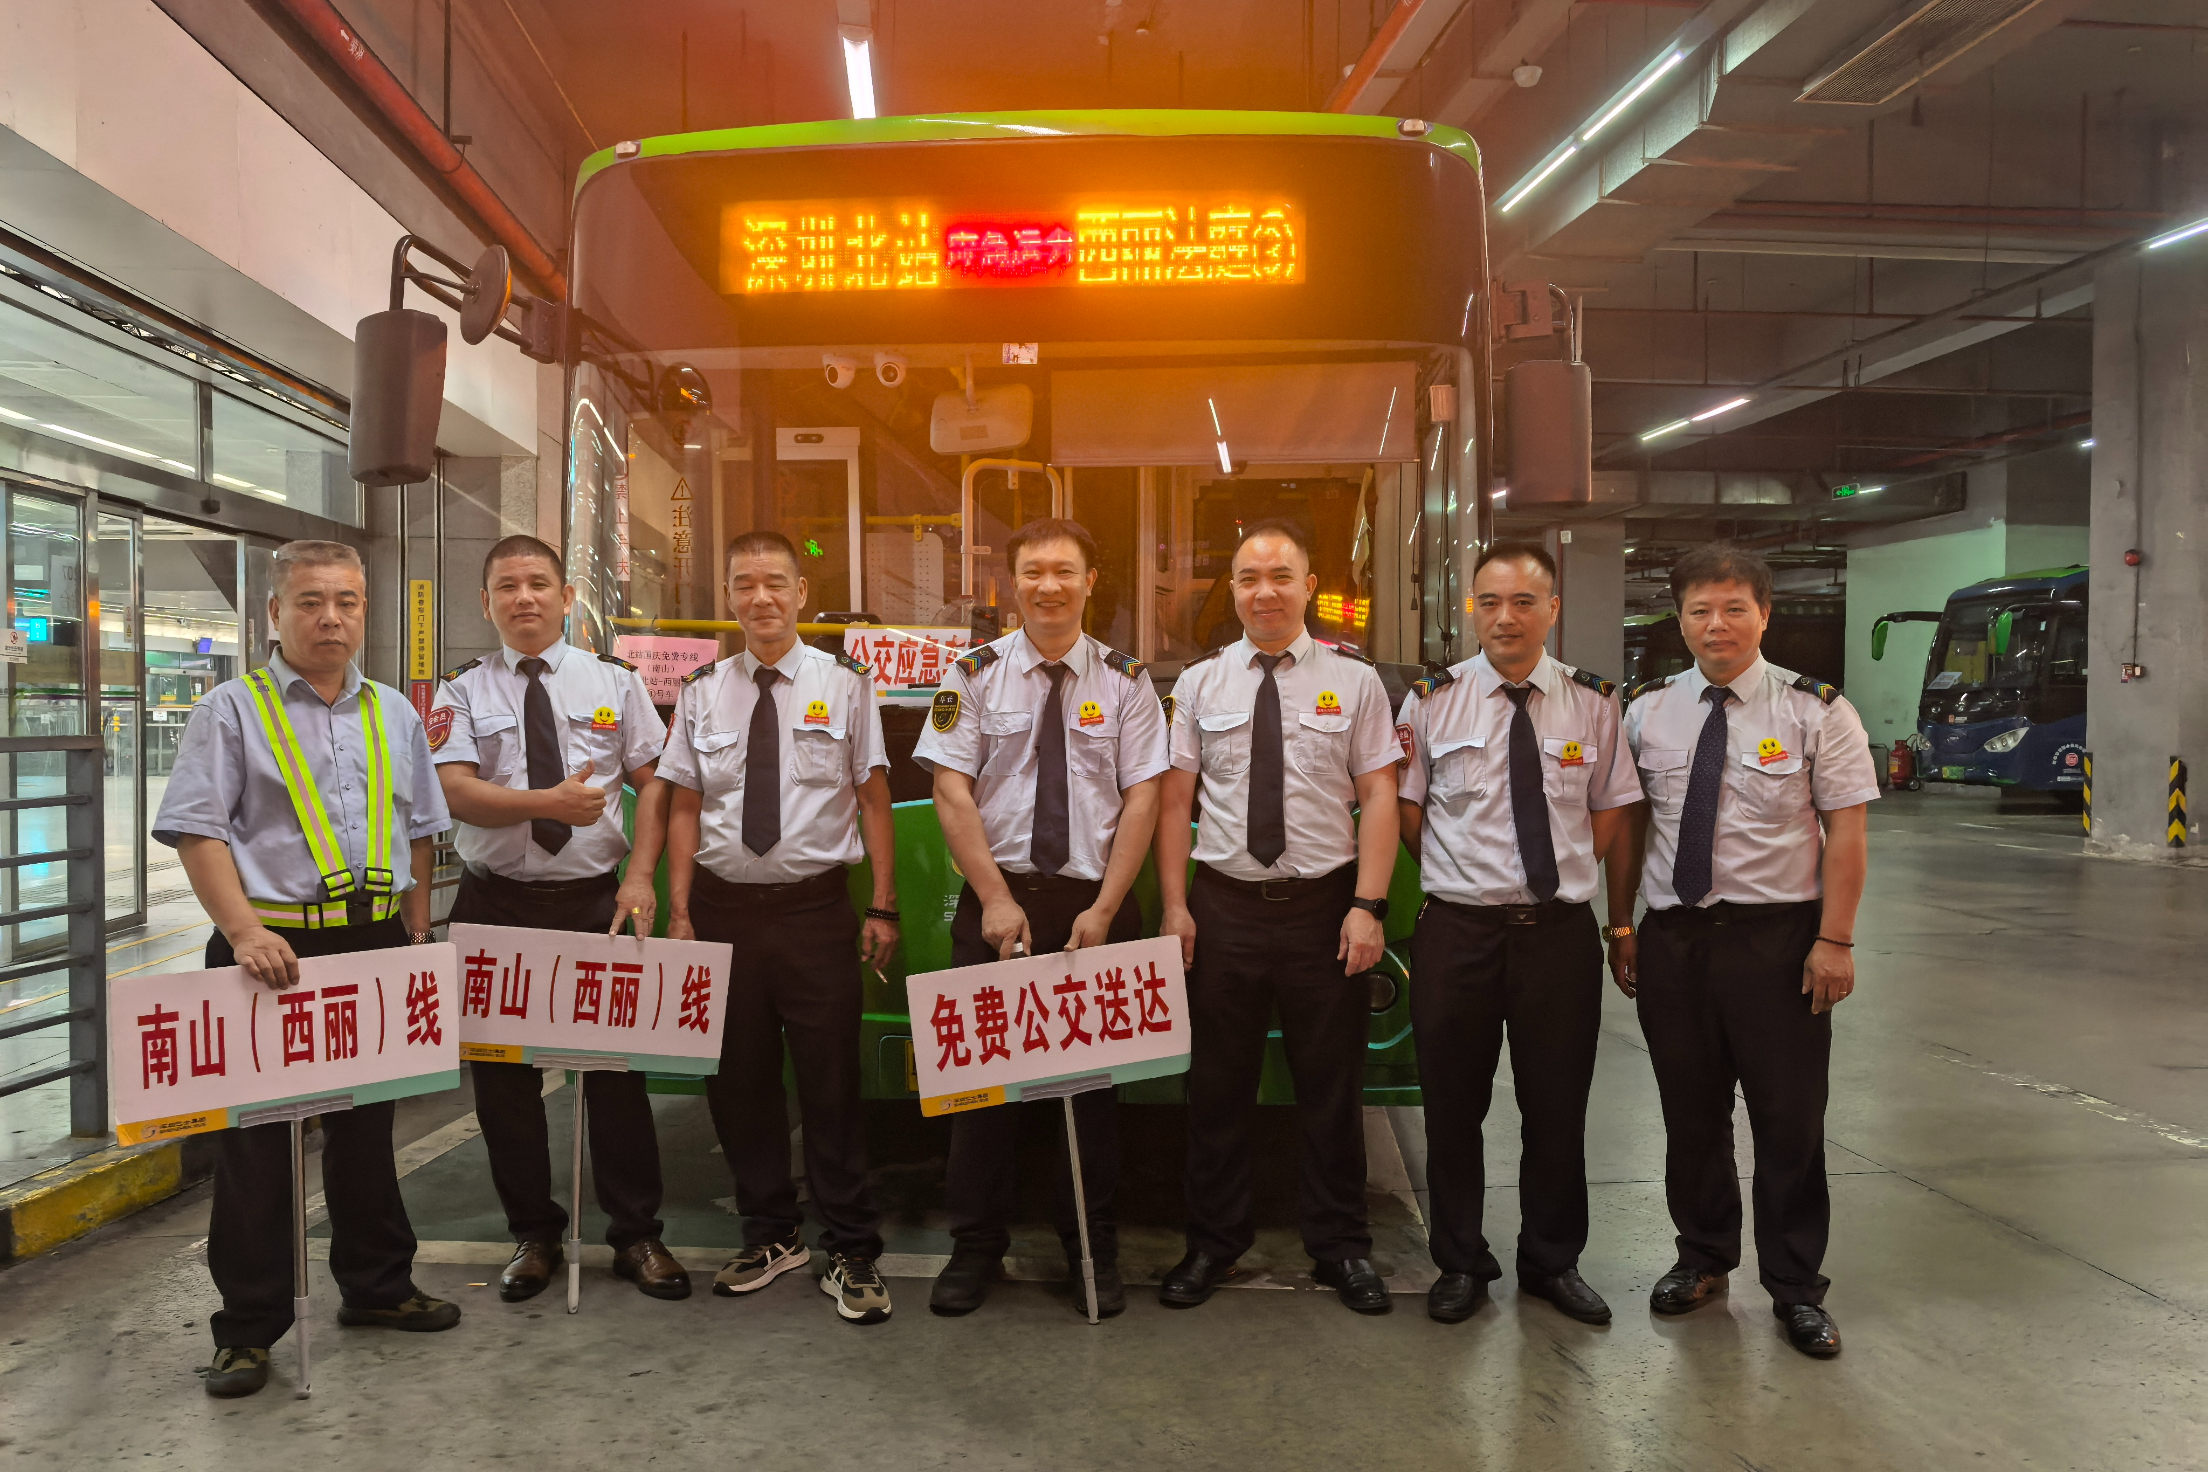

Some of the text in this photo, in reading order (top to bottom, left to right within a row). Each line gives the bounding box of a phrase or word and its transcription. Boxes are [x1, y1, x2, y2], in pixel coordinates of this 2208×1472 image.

[744, 212, 939, 291] 深圳北站
[930, 961, 1173, 1072] 免费公交送达
